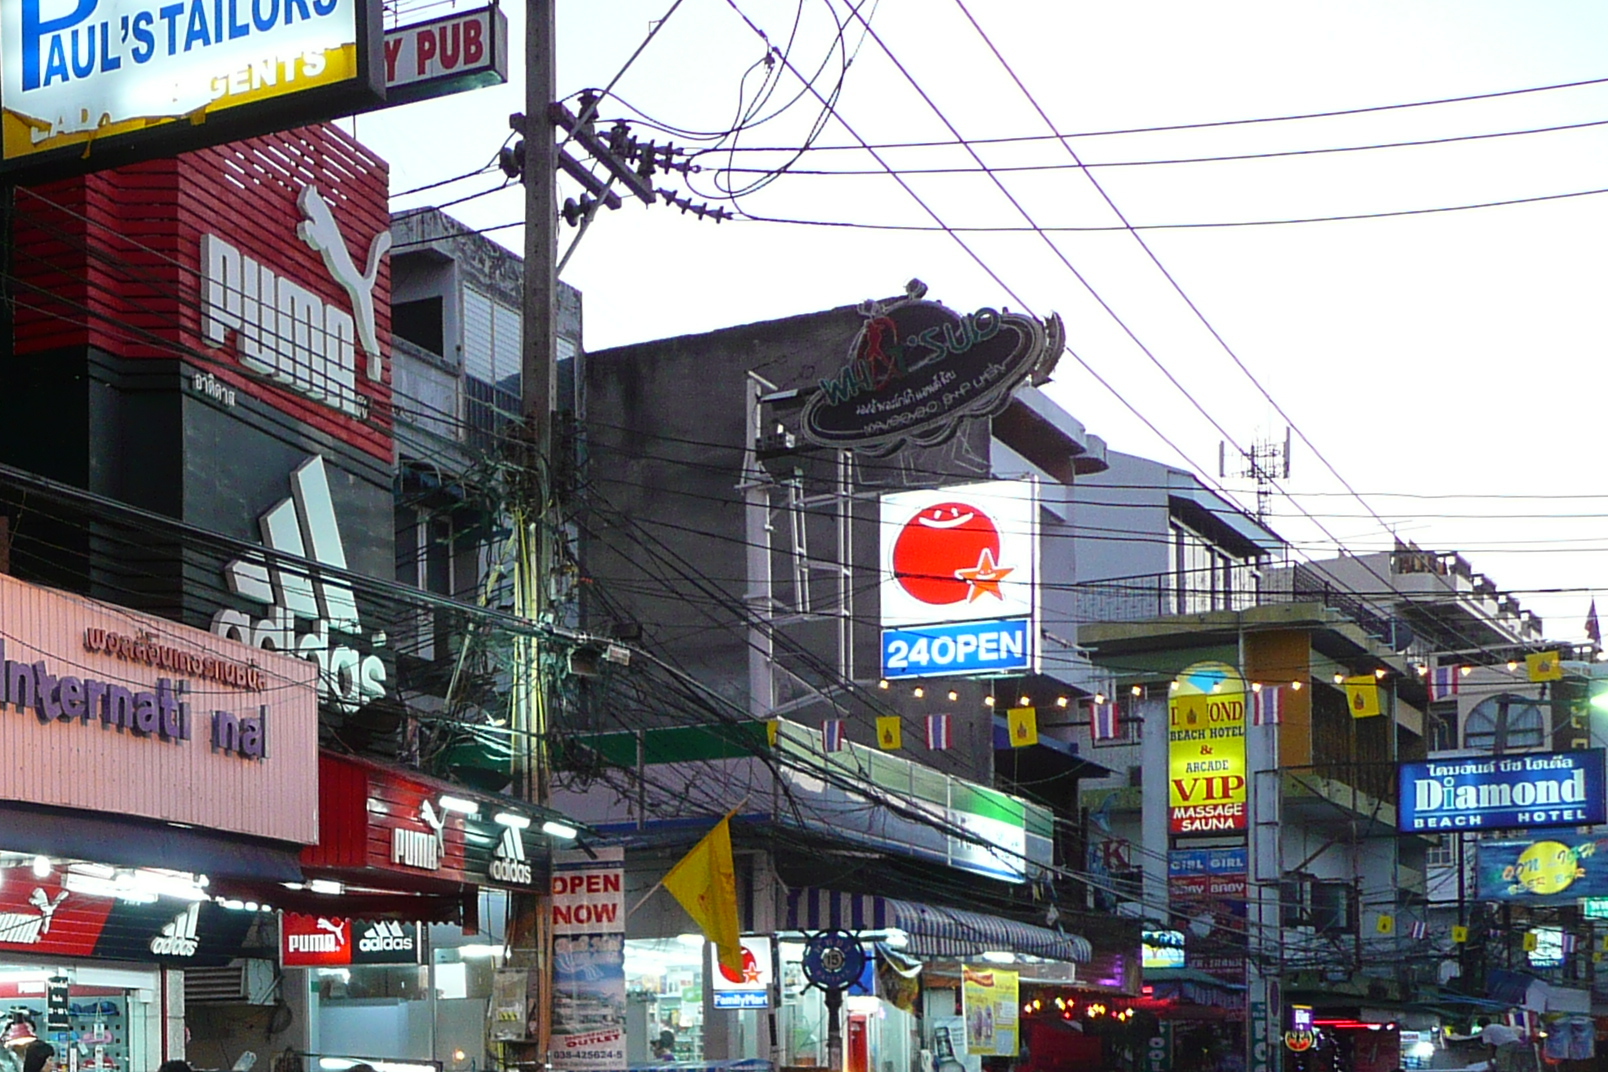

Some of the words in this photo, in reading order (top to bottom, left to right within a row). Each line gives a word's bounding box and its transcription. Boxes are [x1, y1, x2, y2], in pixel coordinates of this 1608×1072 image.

[20, 0, 158, 92] PAUL'S
[416, 20, 484, 76] PUB
[200, 233, 358, 416] PUMA
[1170, 729, 1206, 742] BEACH
[1210, 726, 1244, 739] HOTEL
[1199, 745, 1213, 755] &
[1186, 759, 1219, 773] ARCADE
[1172, 774, 1245, 802] VIP
[1414, 768, 1586, 812] Diamond
[1173, 803, 1243, 819] MASSAGE
[1414, 815, 1482, 828] BEACH
[1518, 810, 1587, 823] HOTEL
[1181, 818, 1235, 832] SAUNA
[392, 828, 437, 870] PUMA
[490, 858, 532, 884] adidas
[1210, 858, 1244, 868] GIRL
[553, 874, 620, 895] OPEN
[553, 903, 618, 925] NOW
[289, 935, 336, 952] PUMA
[359, 935, 413, 951] adidas
[826, 954, 841, 966] 15
[566, 1033, 620, 1047] OUTLET
